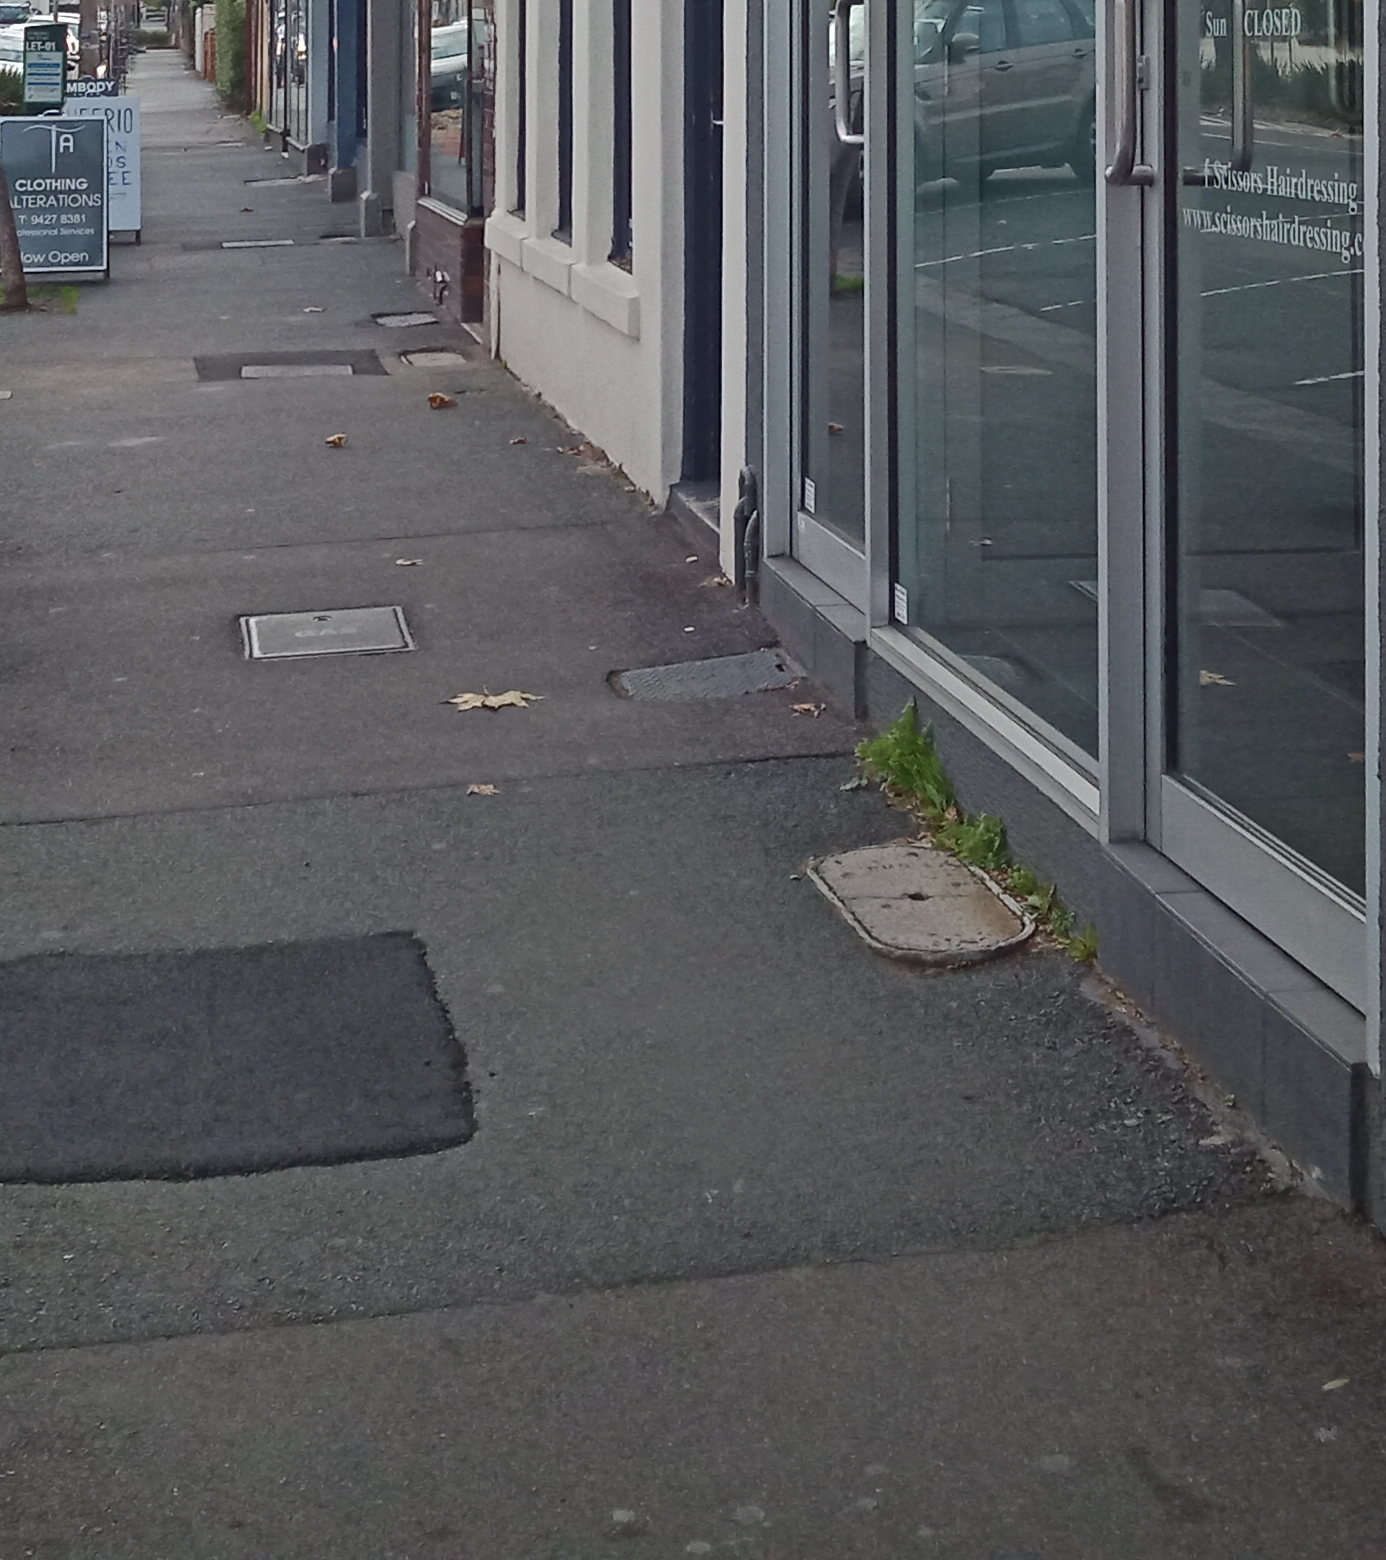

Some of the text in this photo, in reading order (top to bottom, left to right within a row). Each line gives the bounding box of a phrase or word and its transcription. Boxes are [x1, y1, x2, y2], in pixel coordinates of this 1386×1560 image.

[1205, 8, 1301, 37] Sun CLOSED
[66, 81, 115, 93] MBODY
[15, 178, 88, 191] CLOTHING
[1213, 160, 1263, 194] Scissors
[1266, 165, 1357, 214] Hairdressing
[31, 214, 56, 225] 9427
[17, 227, 94, 237] ofessional Services
[48, 251, 89, 264] Open
